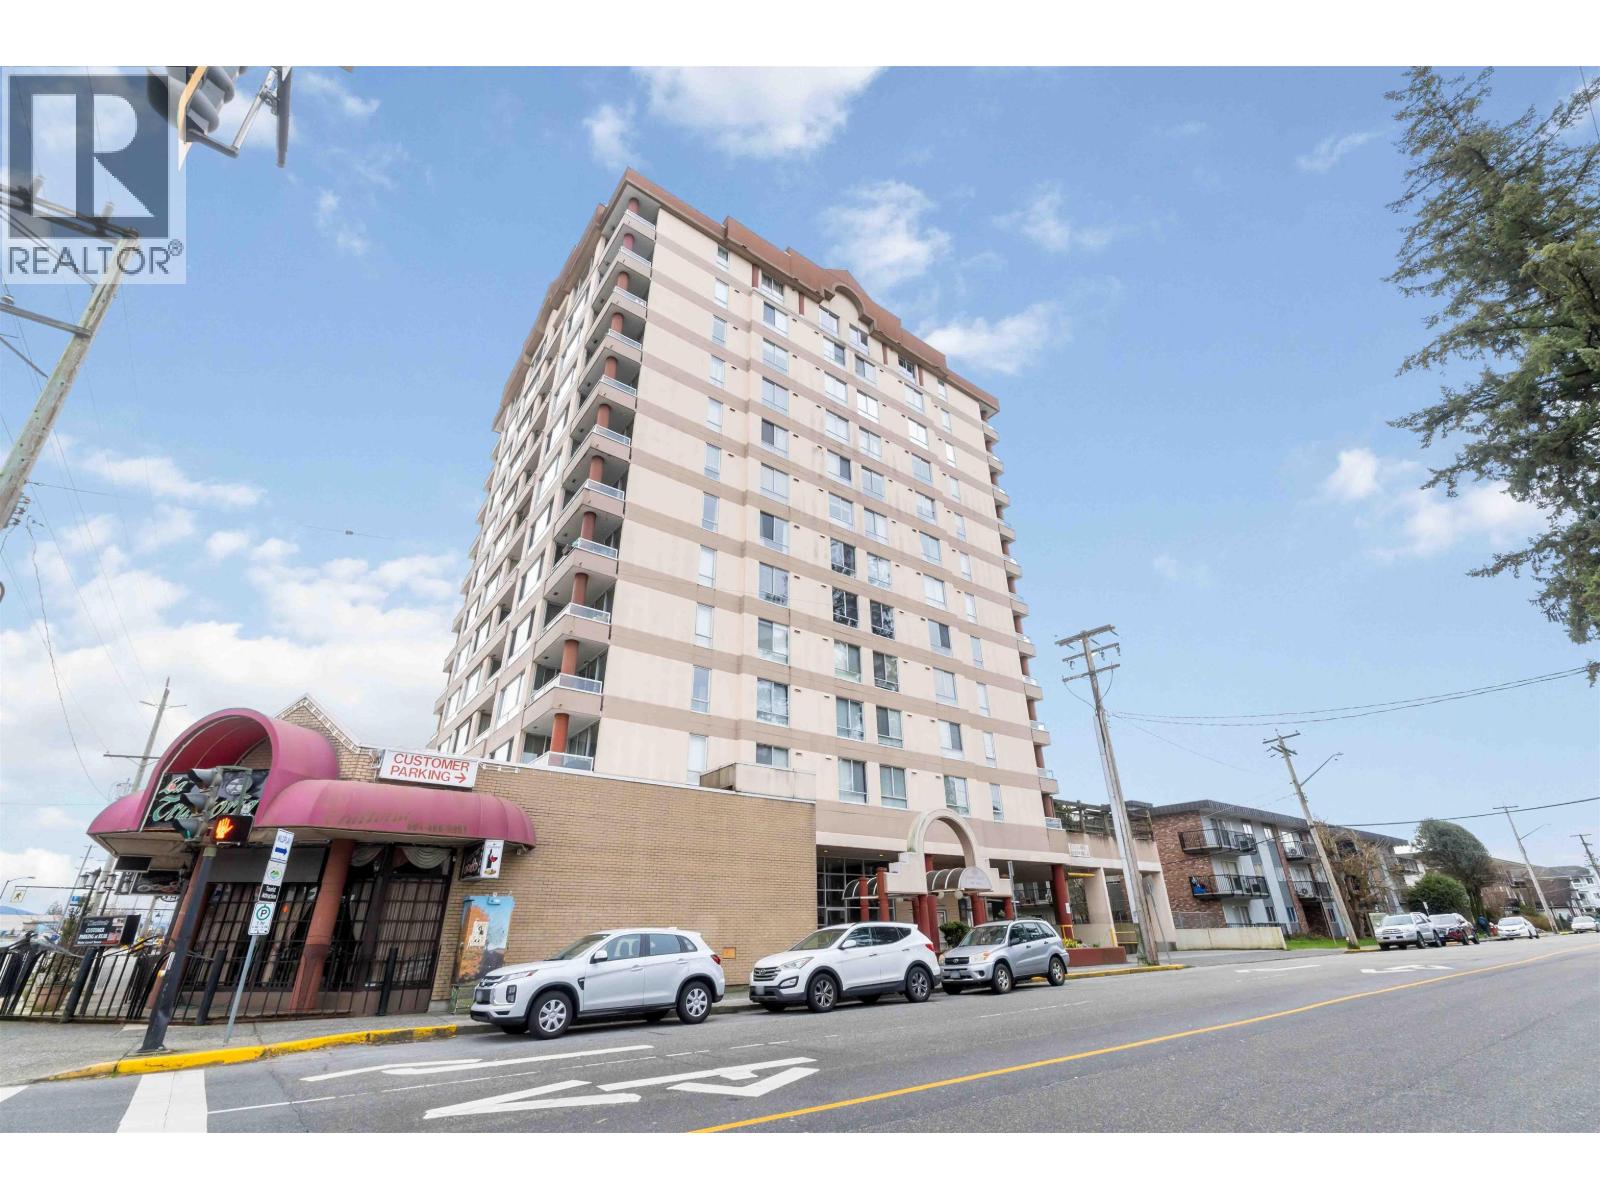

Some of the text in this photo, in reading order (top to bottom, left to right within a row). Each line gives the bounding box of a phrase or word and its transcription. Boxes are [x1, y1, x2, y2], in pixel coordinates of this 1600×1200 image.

[393, 753, 470, 772] CUSTOMER
[390, 765, 451, 782] PARKING
[260, 909, 267, 917] P
